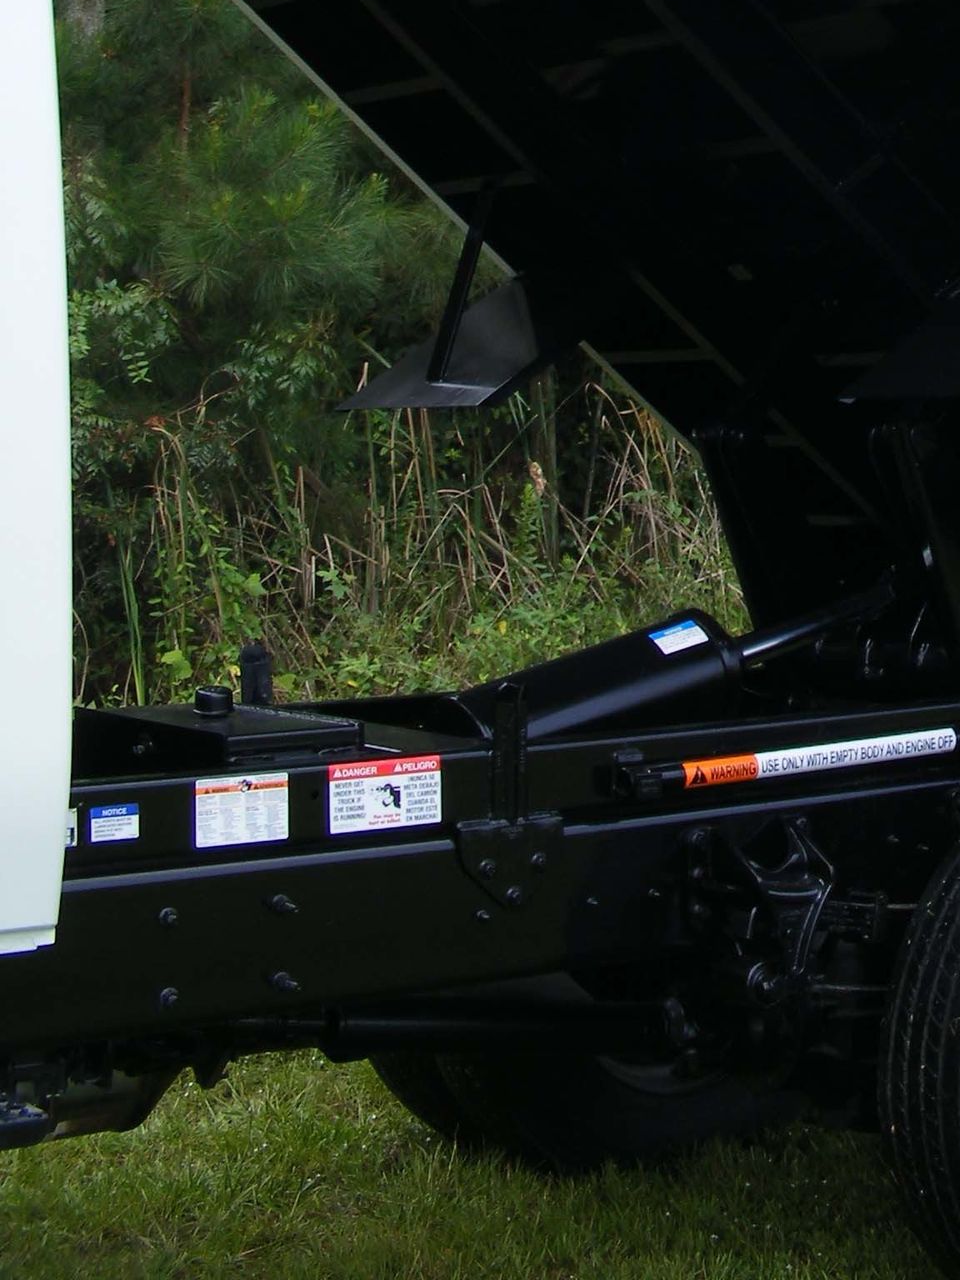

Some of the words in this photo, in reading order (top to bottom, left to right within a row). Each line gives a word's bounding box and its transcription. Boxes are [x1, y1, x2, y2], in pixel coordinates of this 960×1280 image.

[710, 763, 756, 780] WARNING
[762, 759, 779, 773] USE
[781, 755, 804, 771] ONLY
[806, 753, 828, 767] WITH
[830, 748, 859, 764] EMPTY
[860, 744, 884, 760] BODY
[886, 741, 904, 756] AND
[905, 737, 936, 753] ENGINE
[938, 734, 953, 749] OFF
[402, 761, 437, 771] PELIGRO
[342, 766, 377, 777] DANGER
[101, 807, 127, 817] NOTICE
[406, 806, 424, 814] MOTOR
